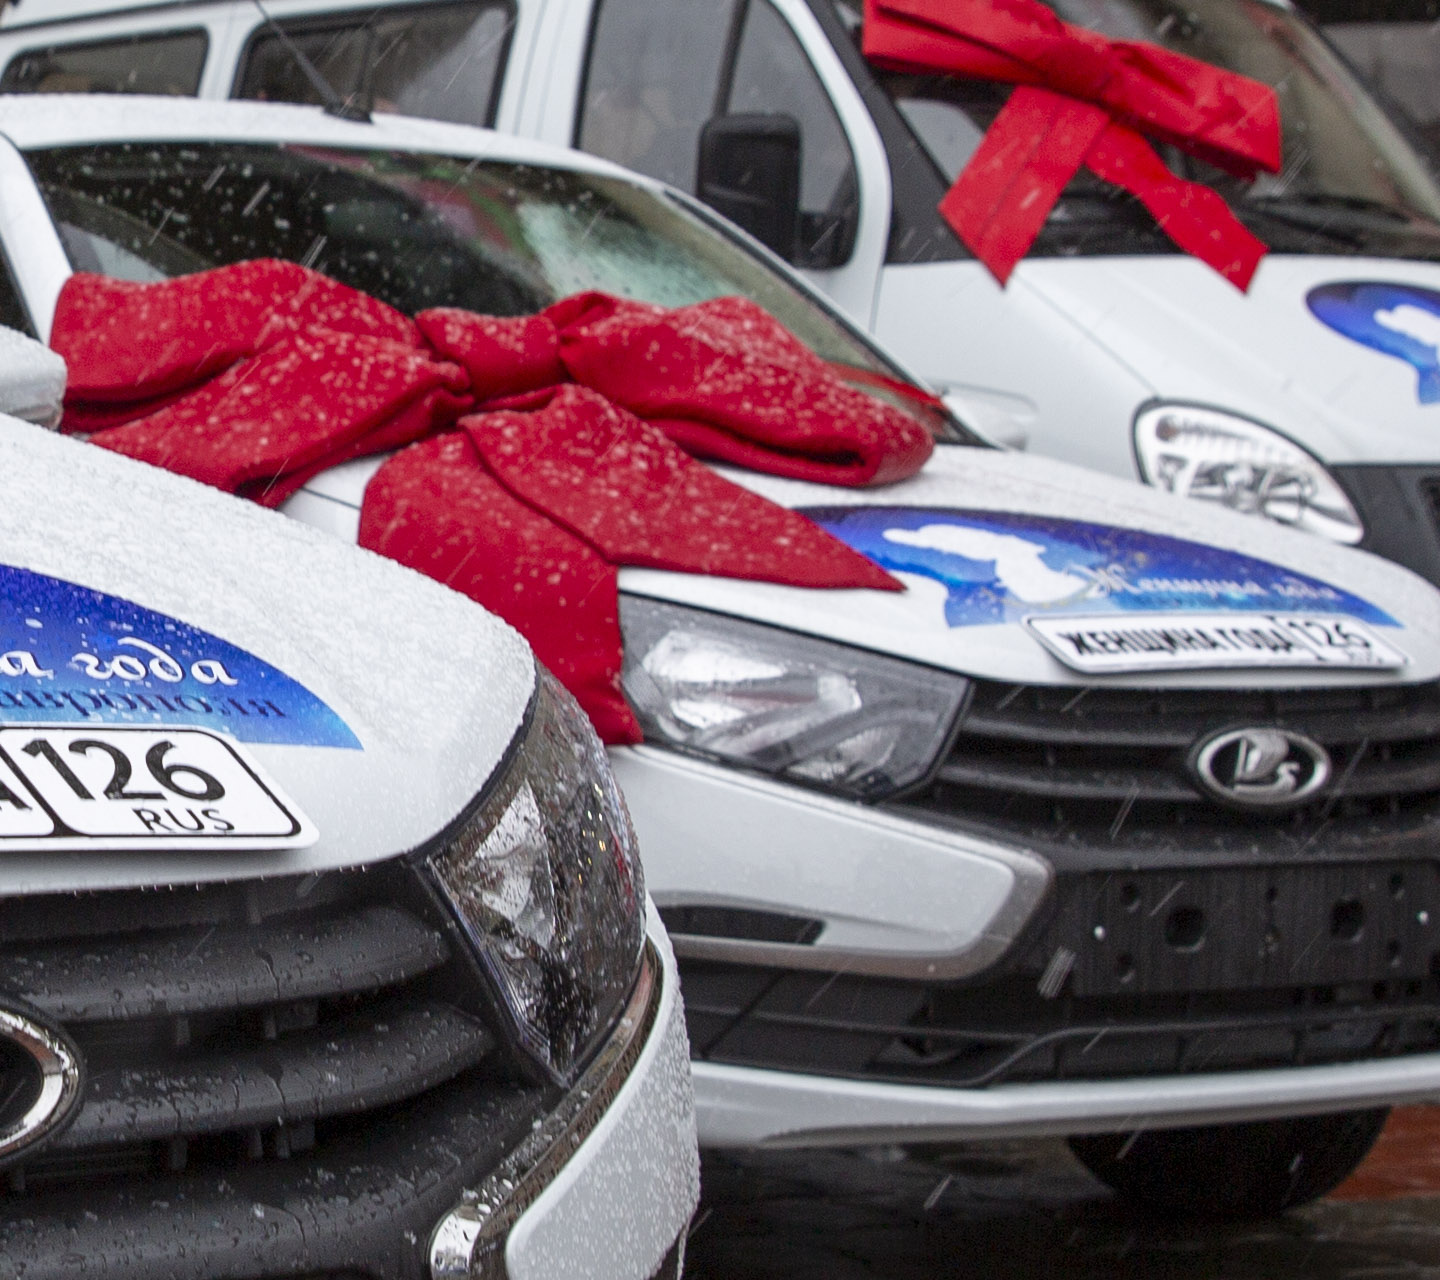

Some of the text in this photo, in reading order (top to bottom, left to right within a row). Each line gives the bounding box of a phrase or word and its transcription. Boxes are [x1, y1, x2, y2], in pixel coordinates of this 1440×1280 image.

[1058, 628, 1294, 656] ЖЕНЩИНА ГОДА
[1288, 621, 1372, 648] 126
[68, 636, 239, 686] года
[21, 738, 226, 801] 126
[132, 807, 236, 832] RUS
